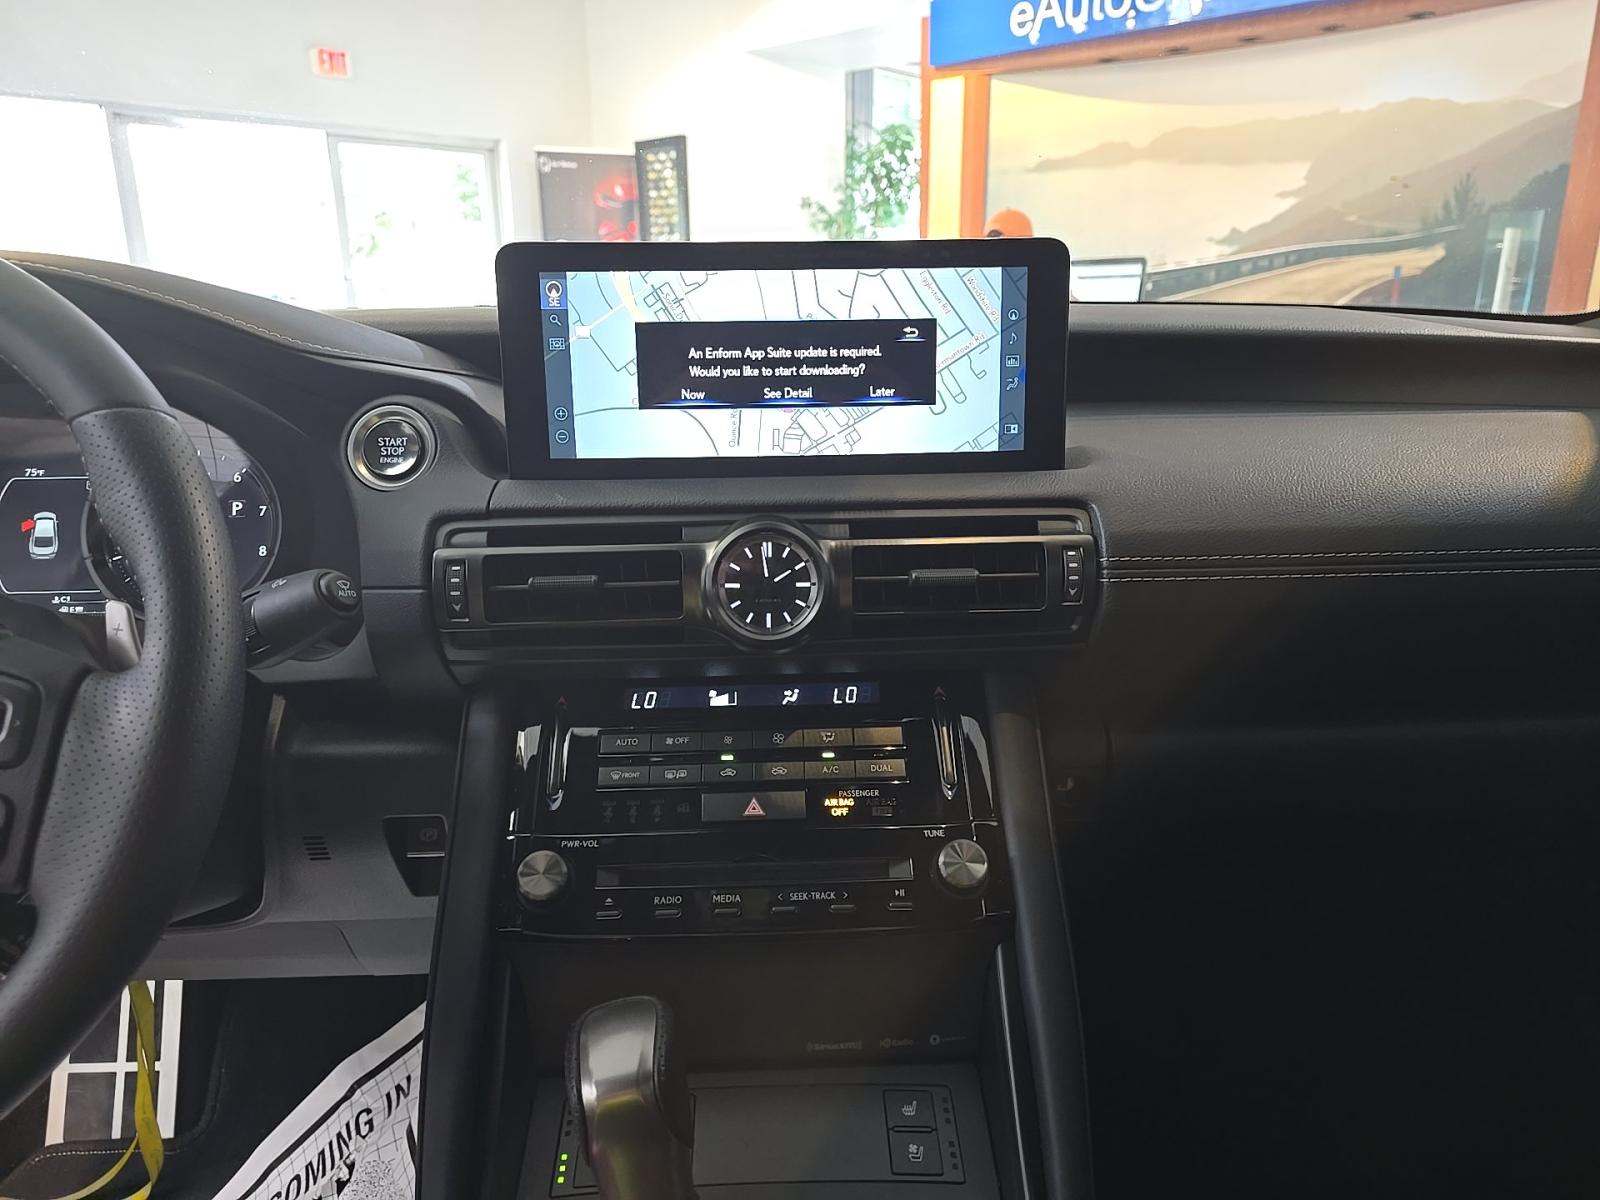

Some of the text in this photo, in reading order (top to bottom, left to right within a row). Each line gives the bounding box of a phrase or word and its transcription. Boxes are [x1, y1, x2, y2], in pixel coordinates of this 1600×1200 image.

[548, 297, 560, 307] SE
[688, 345, 882, 360] An Enform App Suite update is required.
[689, 363, 866, 379] Would you like to start downloading?
[681, 388, 705, 400] Now
[763, 387, 813, 399] See Detail
[869, 386, 896, 398] Later
[377, 437, 408, 446] START
[380, 446, 405, 456] STOP
[379, 456, 404, 464] ENGINE
[233, 472, 242, 483] 6
[231, 501, 243, 516] P
[259, 506, 267, 516] 7
[258, 546, 267, 557] 8
[338, 590, 356, 598] AUTO
[631, 691, 657, 709] LO
[833, 686, 857, 704] LO
[615, 738, 638, 747] AUTO
[674, 737, 690, 745] OFF
[822, 765, 839, 774] A/C
[870, 764, 893, 772] DUAL
[838, 789, 880, 797] PASSENGER
[824, 798, 838, 806] AIR
[838, 797, 855, 806] BAG
[830, 807, 849, 817] OFF
[923, 829, 946, 838] TUNE
[653, 895, 682, 904] RADIO
[712, 894, 742, 904] MEDIA
[386, 1074, 412, 1119] IN
